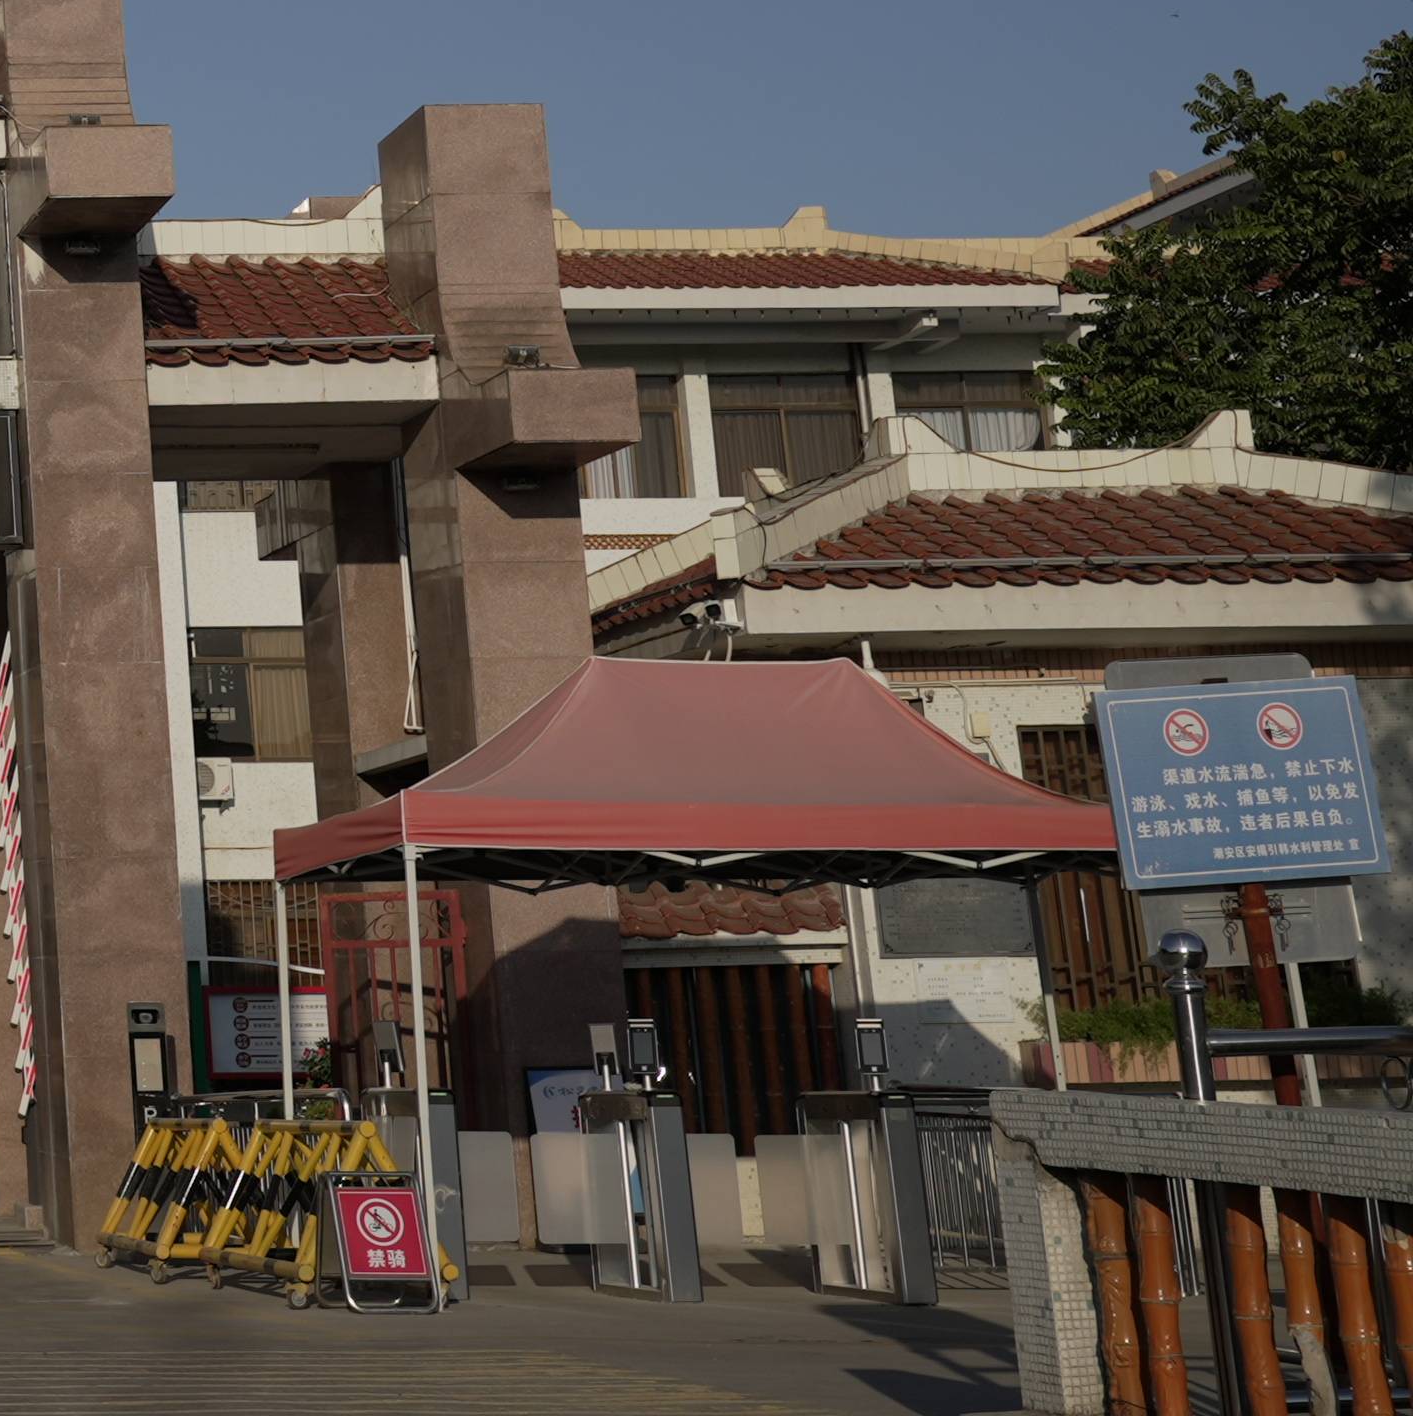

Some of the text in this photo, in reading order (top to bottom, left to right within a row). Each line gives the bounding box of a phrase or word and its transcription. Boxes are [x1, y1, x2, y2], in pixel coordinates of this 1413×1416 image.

[1162, 757, 1355, 786] 渠道水流湍急，禁止下水
[1131, 782, 1360, 813] 游泳、戏水、捕鱼等，以免发
[1136, 808, 1353, 839] 生溺水事故，违者后果自负。
[366, 1249, 406, 1268] 禁骑
